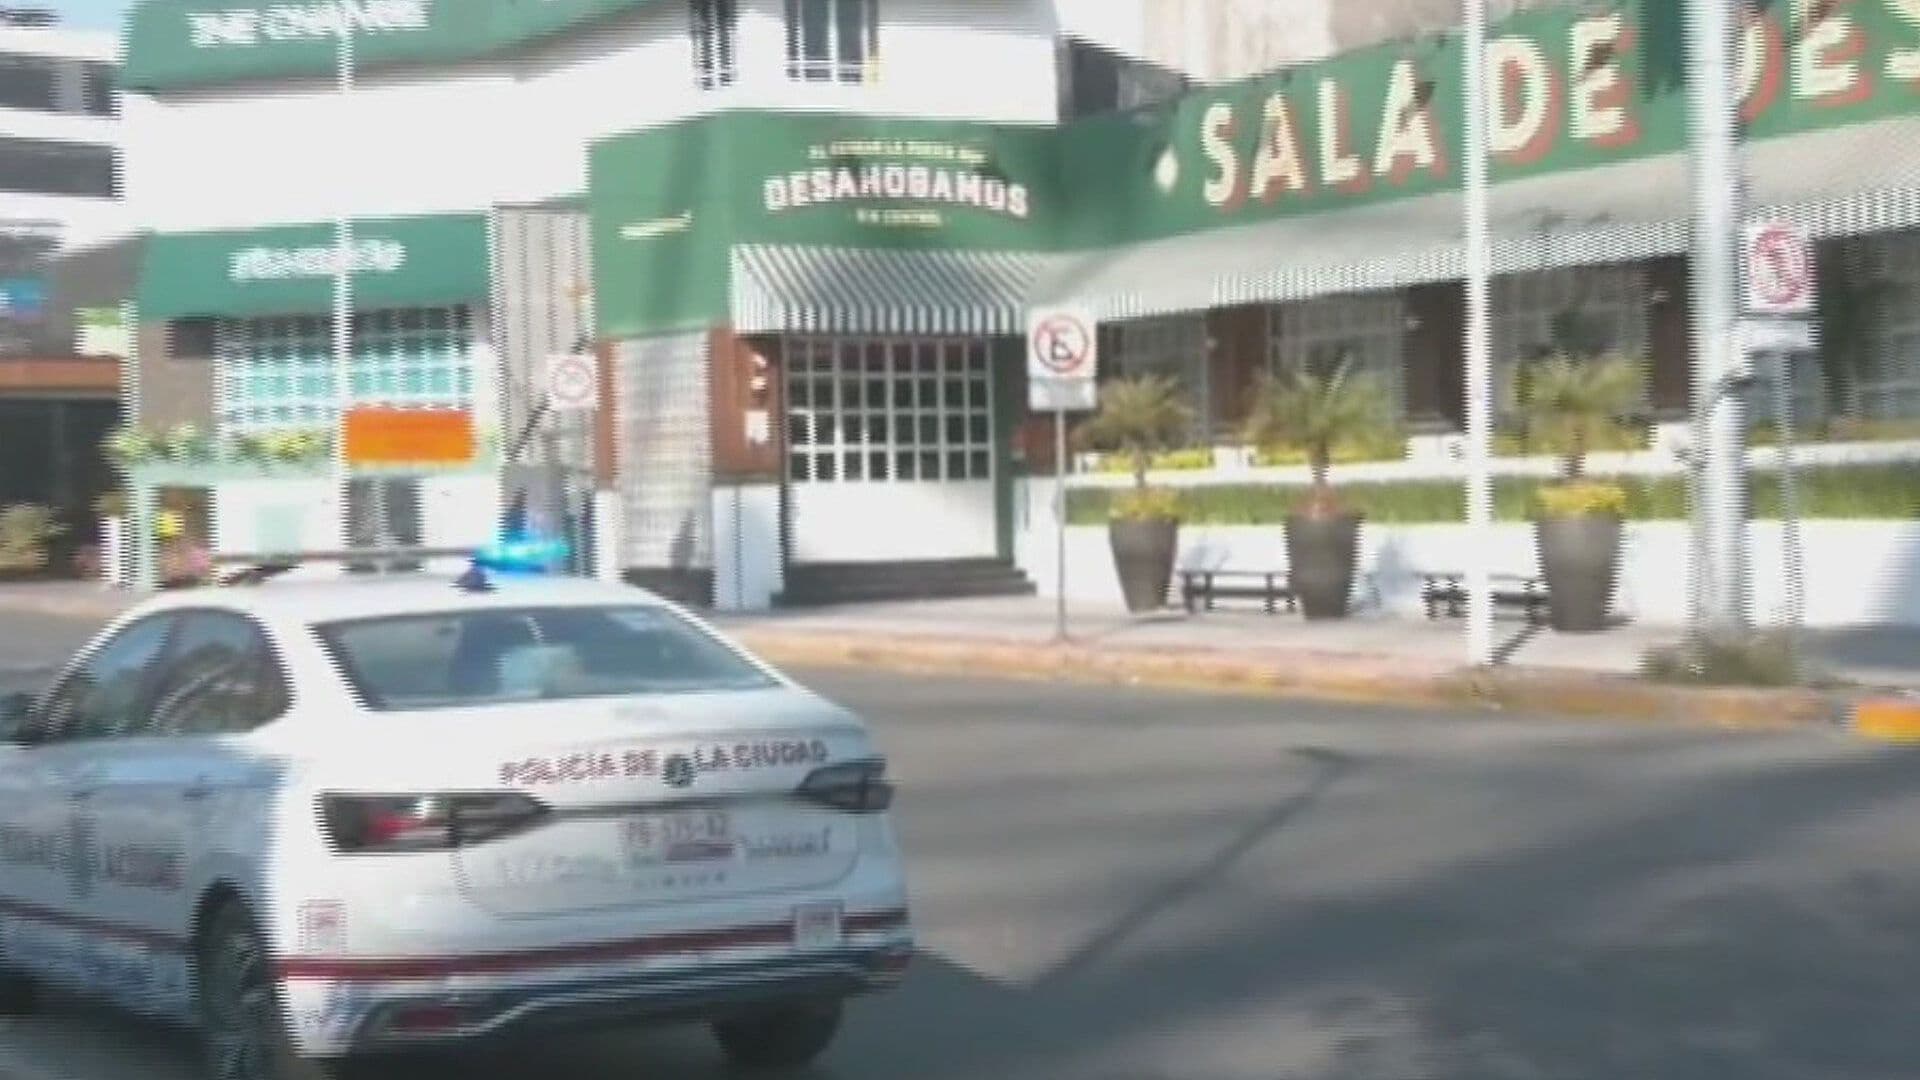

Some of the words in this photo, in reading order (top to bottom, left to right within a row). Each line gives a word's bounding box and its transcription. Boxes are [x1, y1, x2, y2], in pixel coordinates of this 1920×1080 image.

[1201, 62, 1434, 205] SALA
[1485, 15, 1625, 154] DE
[622, 749, 660, 777] DE
[695, 745, 731, 770] LA
[732, 738, 829, 769] CIUDAD
